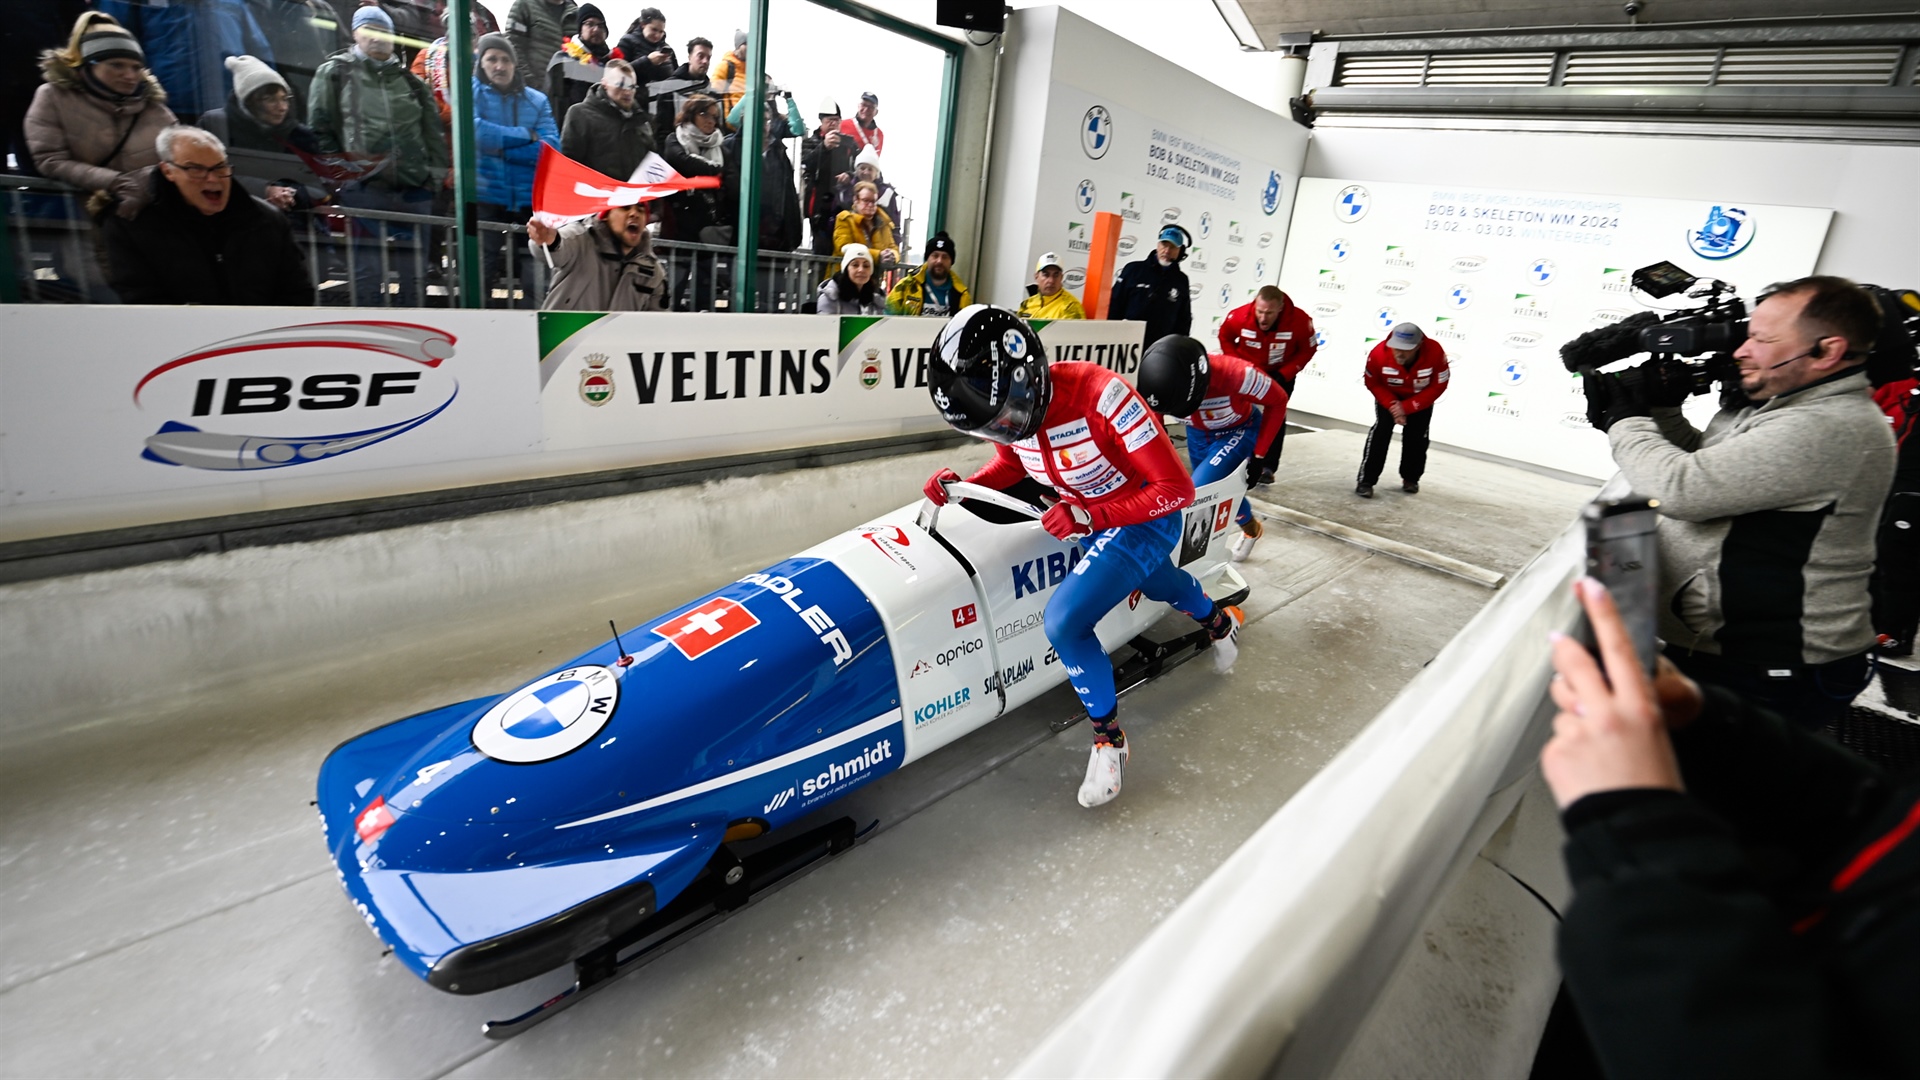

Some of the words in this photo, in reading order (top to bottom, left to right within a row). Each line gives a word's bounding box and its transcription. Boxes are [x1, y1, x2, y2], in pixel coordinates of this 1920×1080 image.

[1146, 163, 1169, 180] 19.02.
[1176, 172, 1196, 189] 03.03.
[1149, 145, 1166, 161] BOB
[1167, 151, 1173, 163] &
[1175, 153, 1210, 175] SKELETON
[1211, 167, 1222, 179] WM
[1222, 171, 1239, 185] 2024
[1428, 204, 1455, 216] BOB
[1460, 207, 1467, 217] &
[1472, 207, 1545, 223] SKELETON
[1550, 213, 1575, 225] WM
[1580, 215, 1619, 229] 2024
[1424, 219, 1462, 233] 19.02.
[1476, 223, 1517, 237] 03.03.
[1521, 228, 1613, 246] WINTERBERG
[989, 340, 999, 406] STADLER
[1055, 343, 1139, 374] VELTINS
[627, 349, 830, 405] VELTINS
[191, 371, 421, 417] IBSF
[1116, 402, 1140, 427] KOHLER
[1049, 426, 1088, 441] STADLER
[1209, 428, 1245, 466] STADLE
[1075, 463, 1103, 480] schmidt
[1149, 496, 1185, 517] OMEGA
[1072, 527, 1121, 575] STAD
[1011, 546, 1083, 600] KIBA
[736, 573, 853, 666] TADLER
[956, 608, 965, 624] 4
[936, 638, 983, 667] aprica
[914, 687, 970, 725] KOHLER
[413, 760, 452, 786] 4
[802, 739, 892, 796] schmidt
[807, 792, 826, 805] brand
